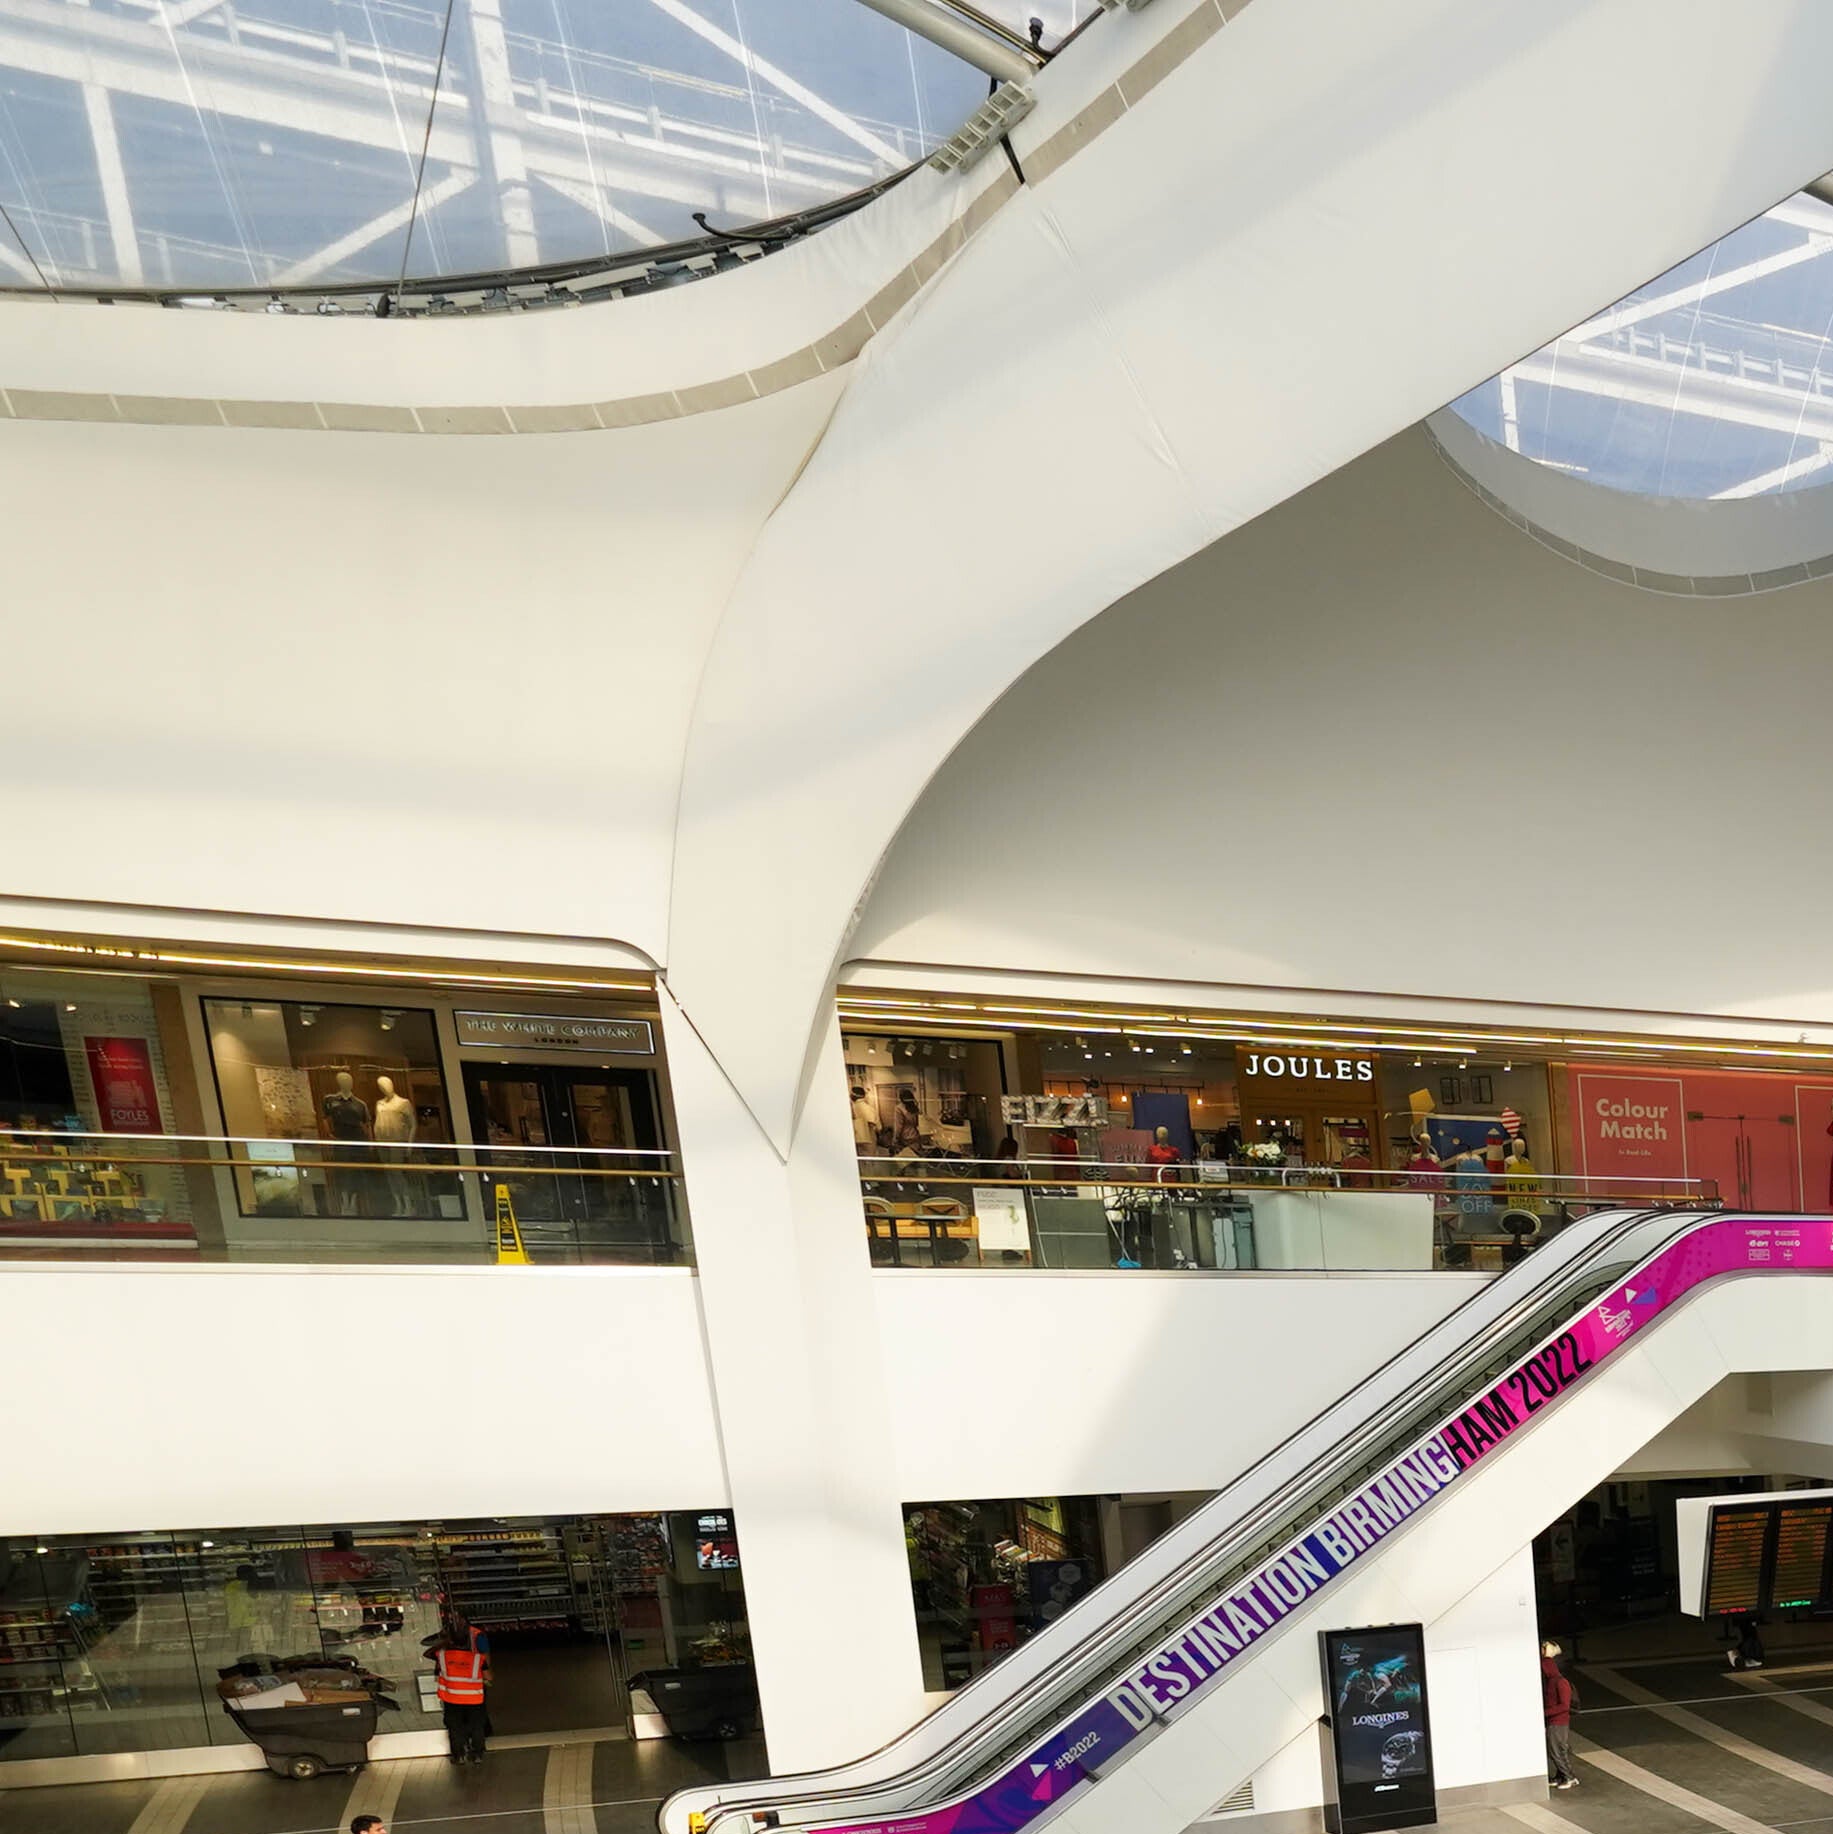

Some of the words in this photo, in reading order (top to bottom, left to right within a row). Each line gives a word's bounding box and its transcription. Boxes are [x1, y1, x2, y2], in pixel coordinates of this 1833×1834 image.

[560, 1025, 640, 1039] COMPANY
[1245, 1054, 1374, 1081] JOULES
[110, 1108, 149, 1122] FOYLES
[1596, 1098, 1668, 1120] Colour
[1600, 1121, 1668, 1142] Match
[1461, 1199, 1492, 1214] OFF
[1106, 1542, 1330, 1734] DESTINATION
[1320, 1401, 1517, 1577] BIRMINGHAM
[1506, 1332, 1594, 1414] 2022
[1352, 1711, 1410, 1727] LONGINES
[1054, 1729, 1101, 1774] #B2022
